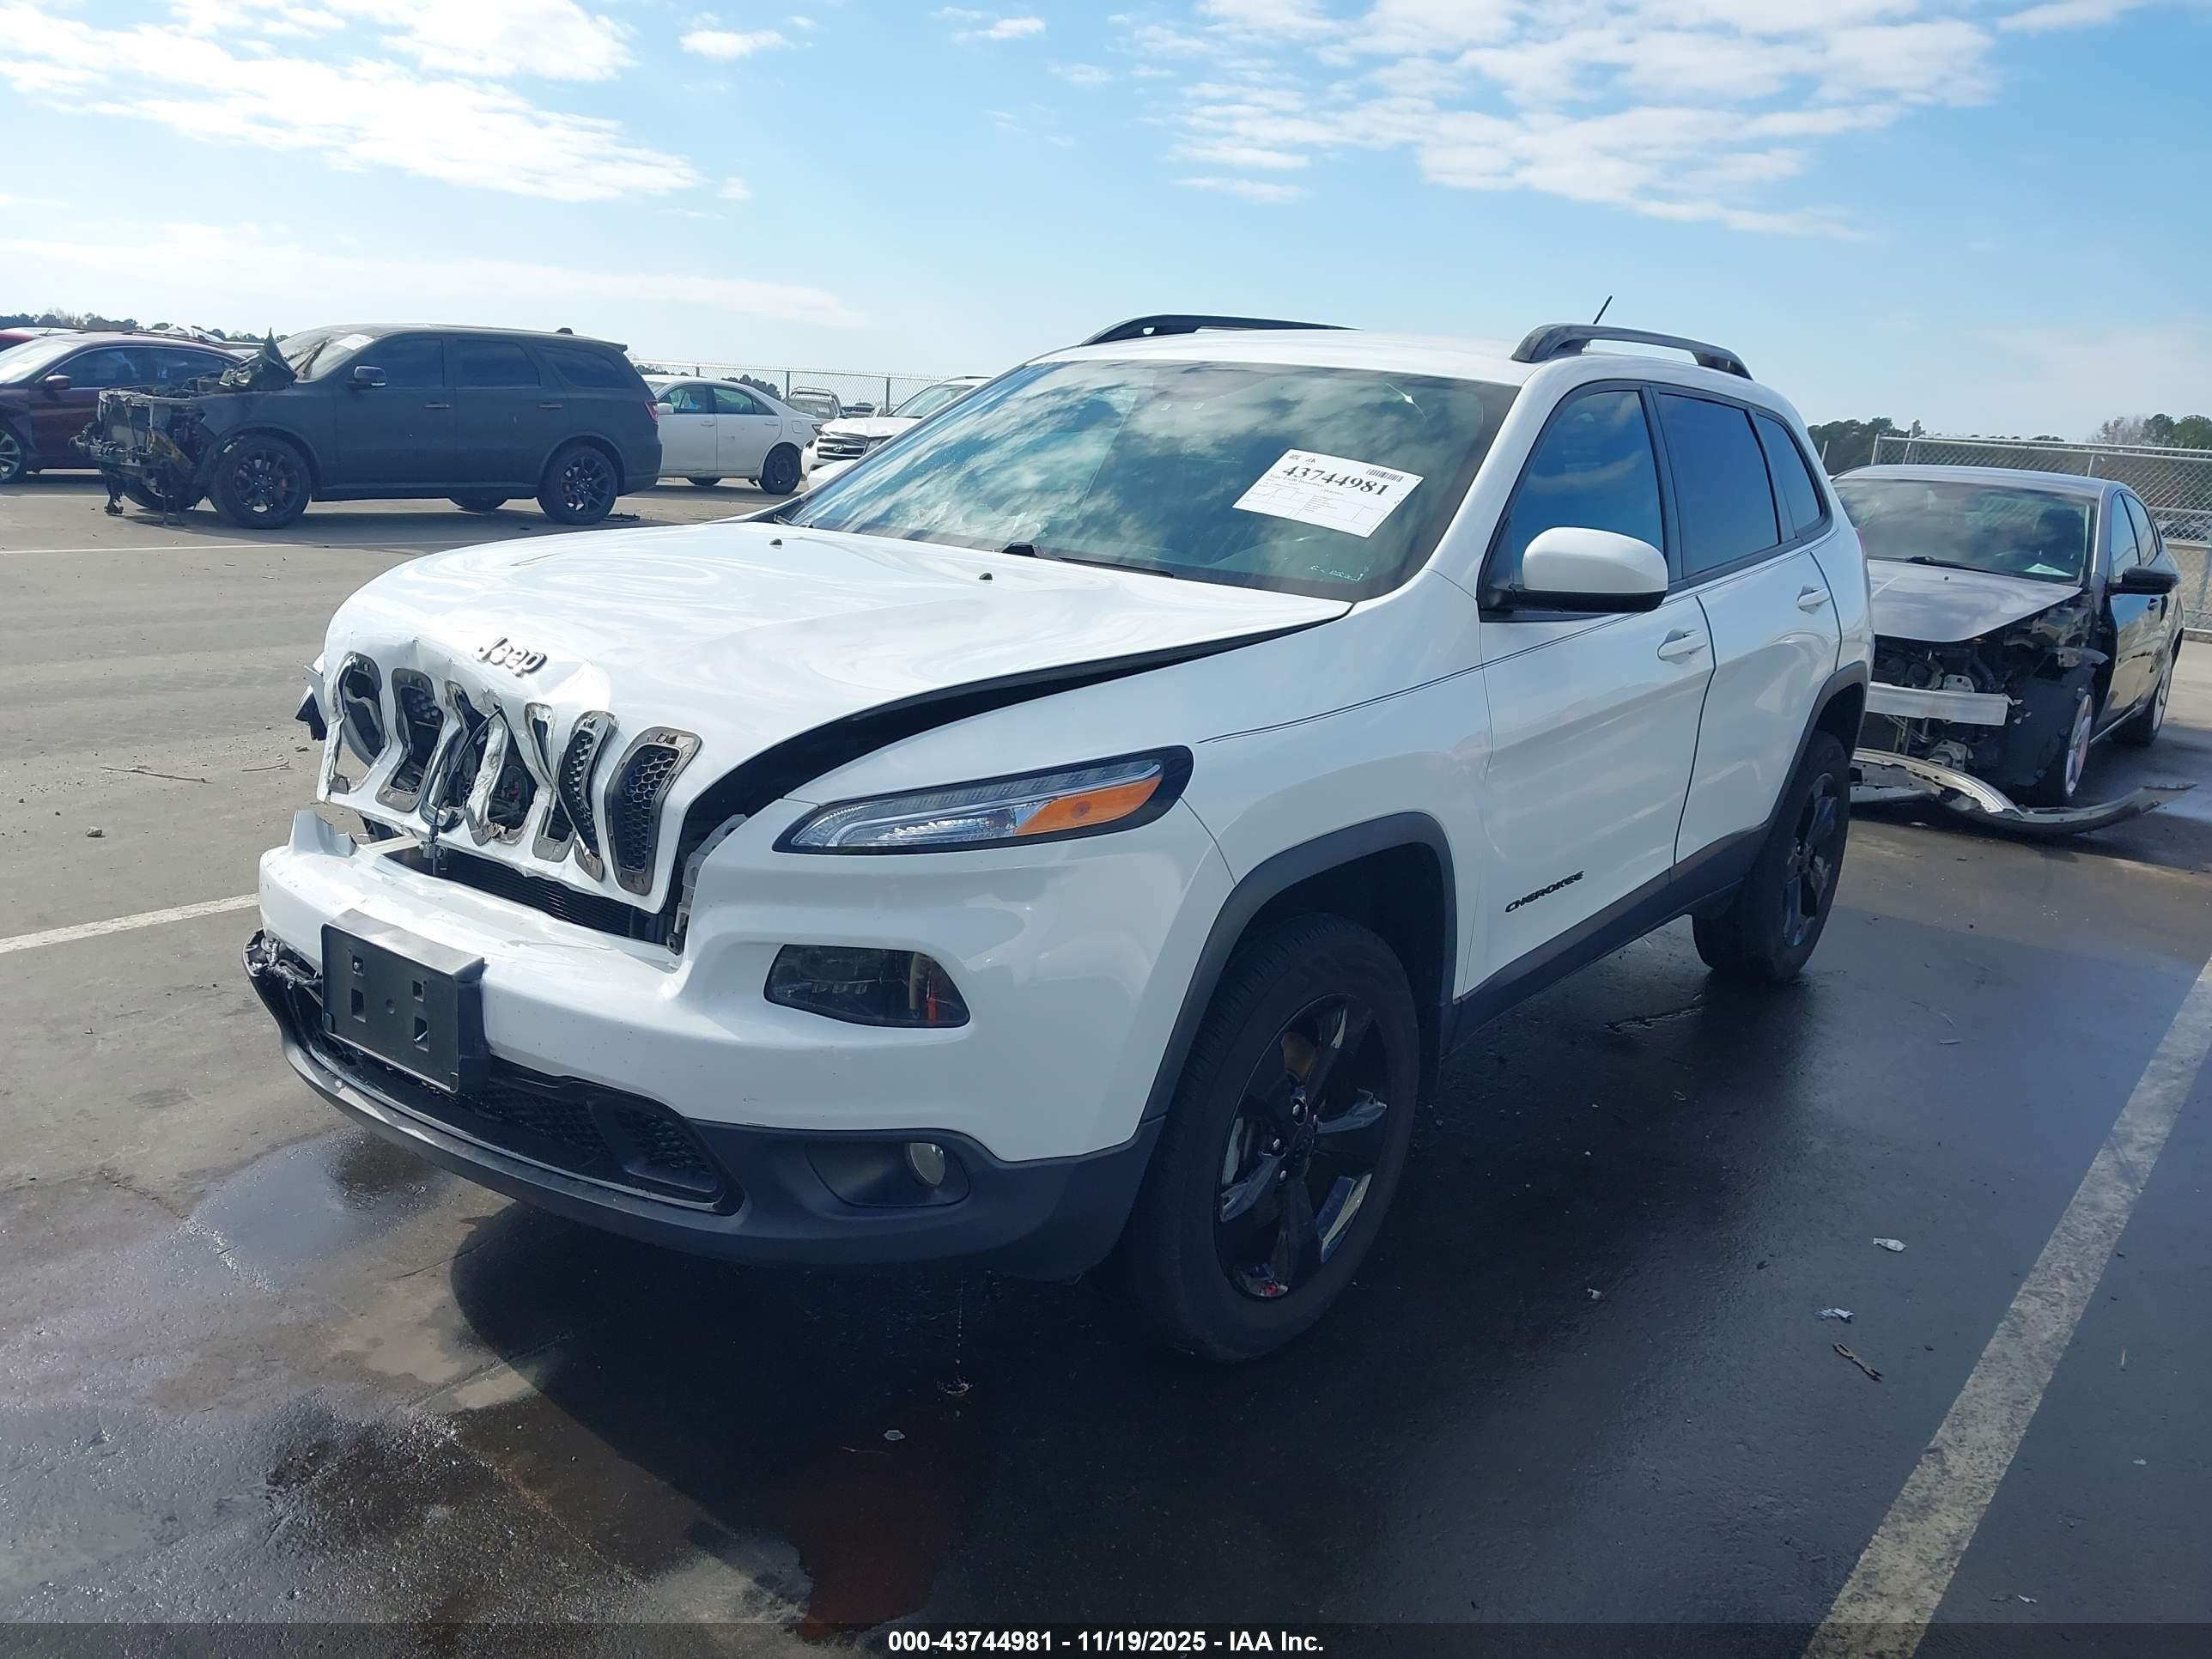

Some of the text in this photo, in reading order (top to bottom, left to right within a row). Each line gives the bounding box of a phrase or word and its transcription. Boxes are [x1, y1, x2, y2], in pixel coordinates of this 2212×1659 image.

[1282, 465, 1389, 495] 43744981
[471, 637, 547, 678] Jeep
[1505, 870, 1585, 913] CHEROKEE
